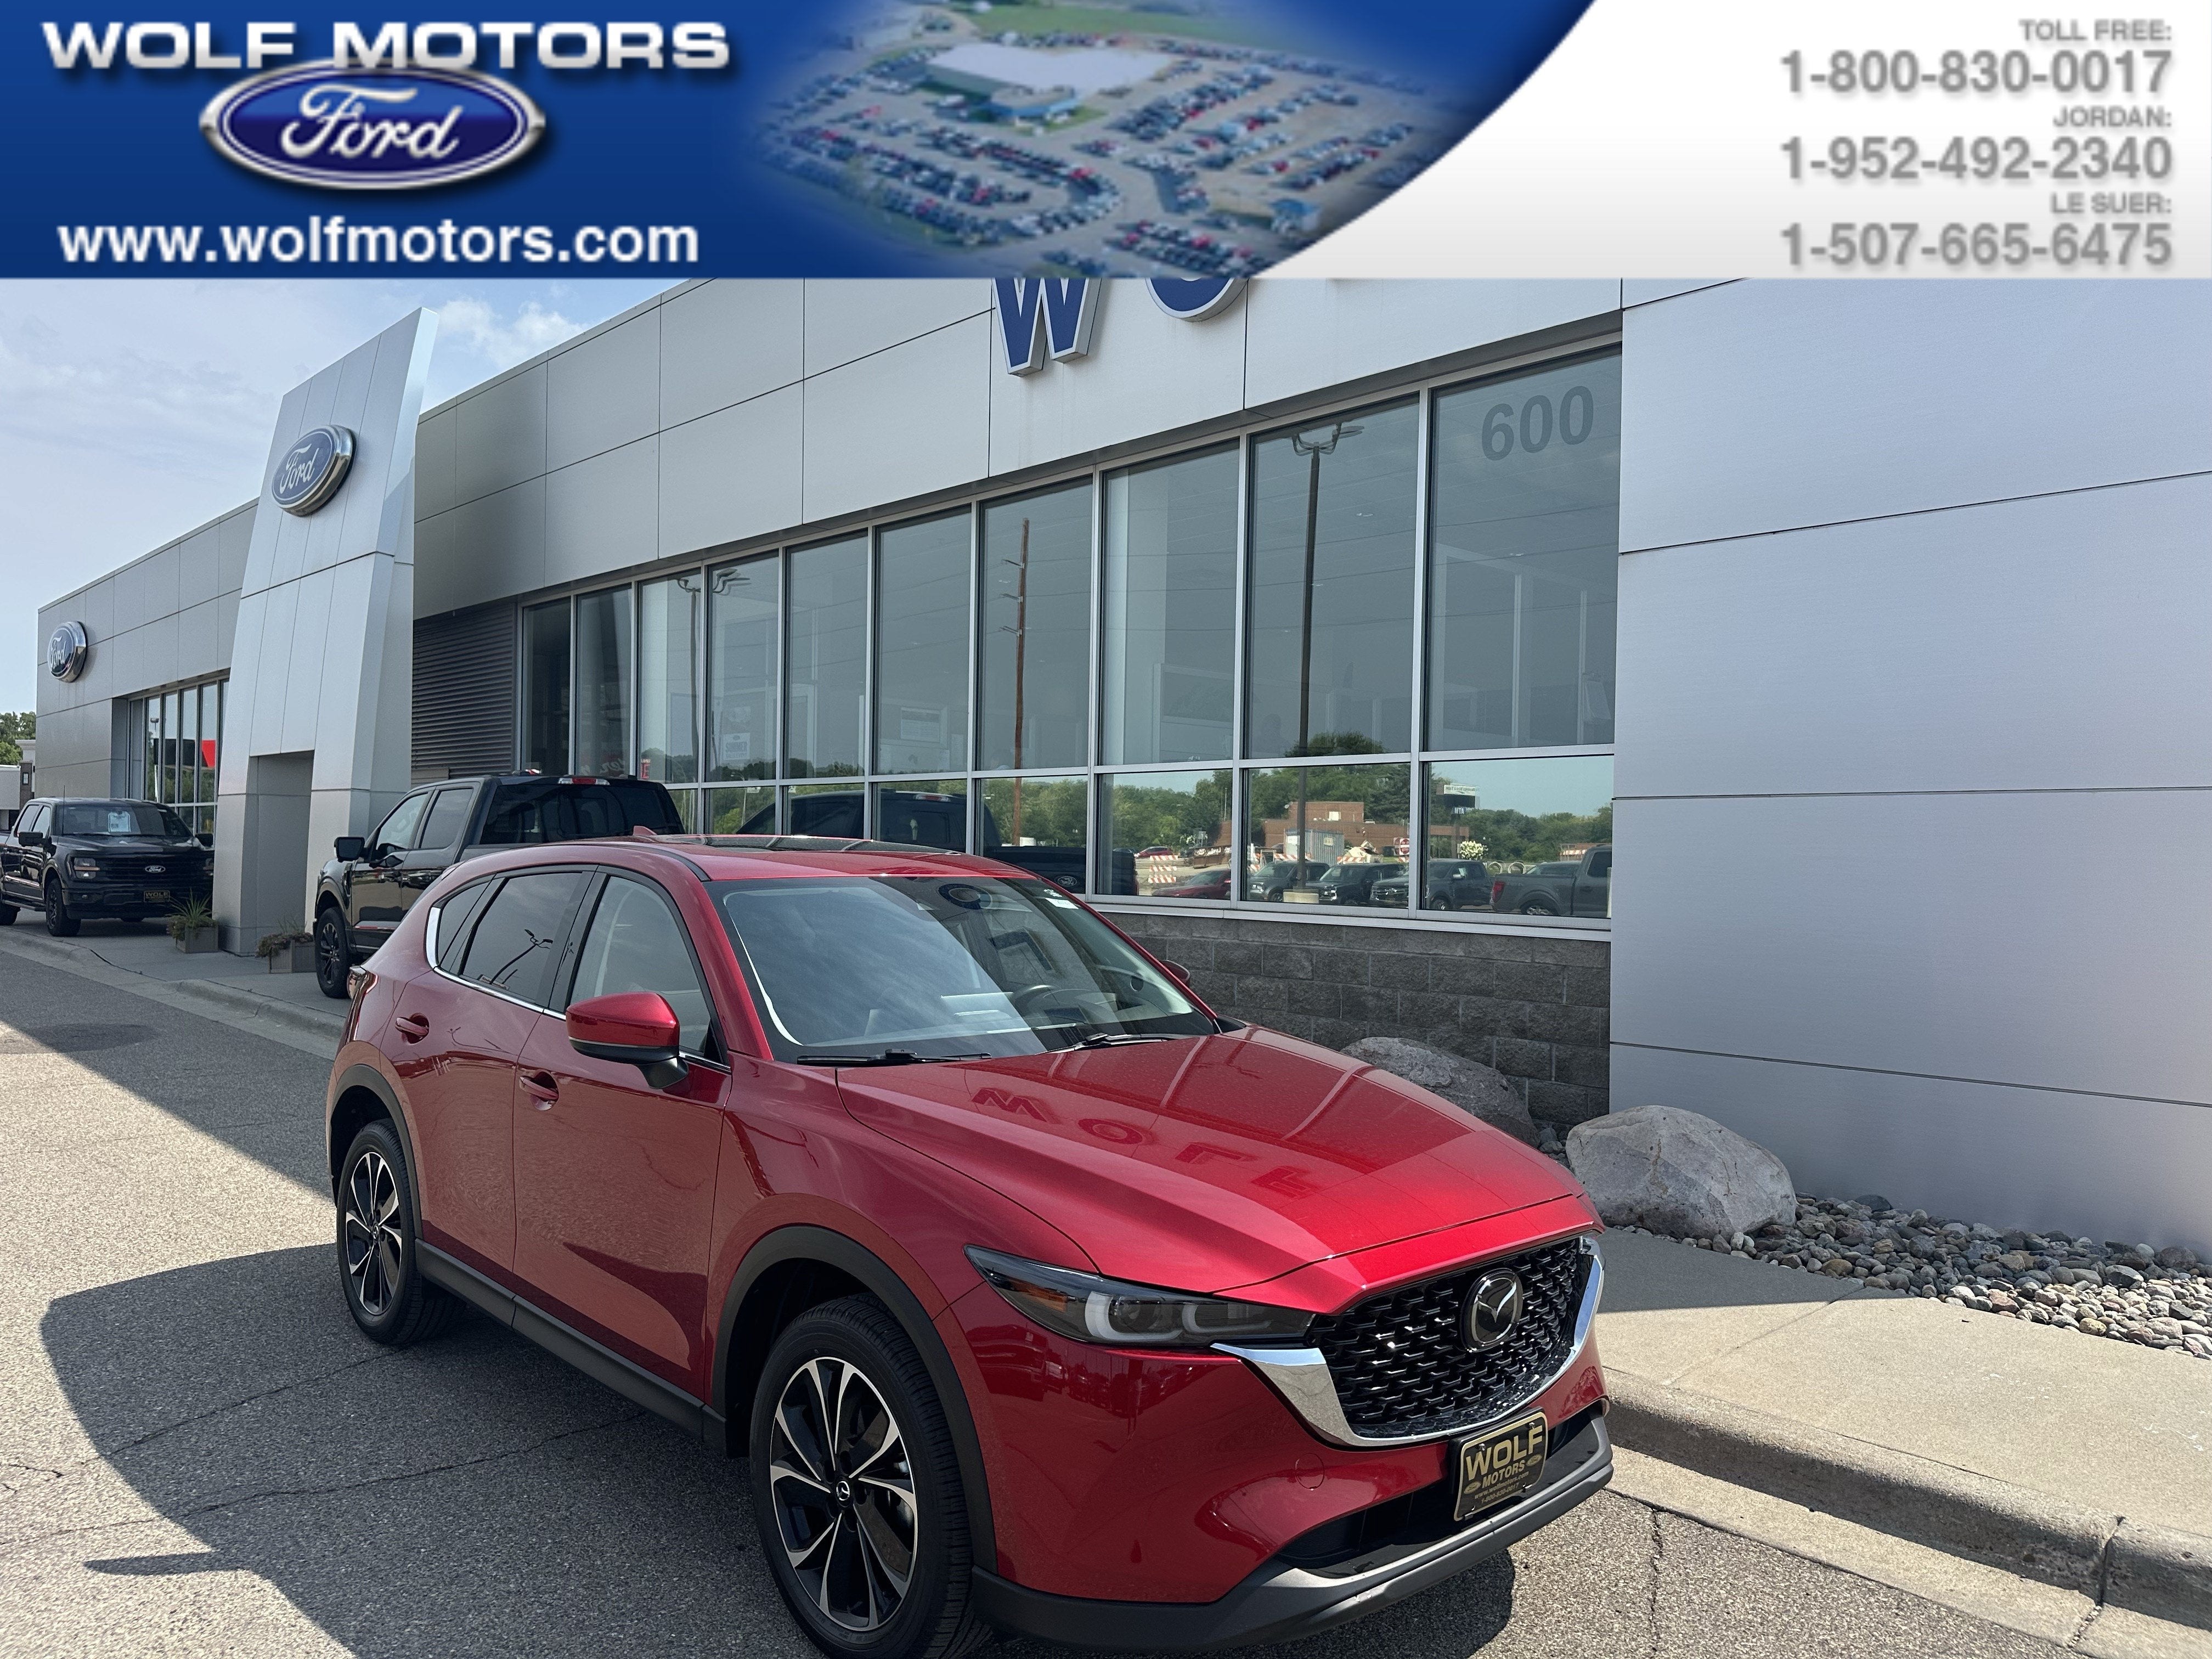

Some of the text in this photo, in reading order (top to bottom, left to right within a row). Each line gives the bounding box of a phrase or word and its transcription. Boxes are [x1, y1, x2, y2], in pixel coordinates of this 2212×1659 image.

[1481, 386, 1594, 461] 600
[279, 443, 320, 494] Ford
[50, 636, 66, 671] Ford
[1465, 1425, 1543, 1481] WOLF
[1482, 1460, 1525, 1488] MOTORS
